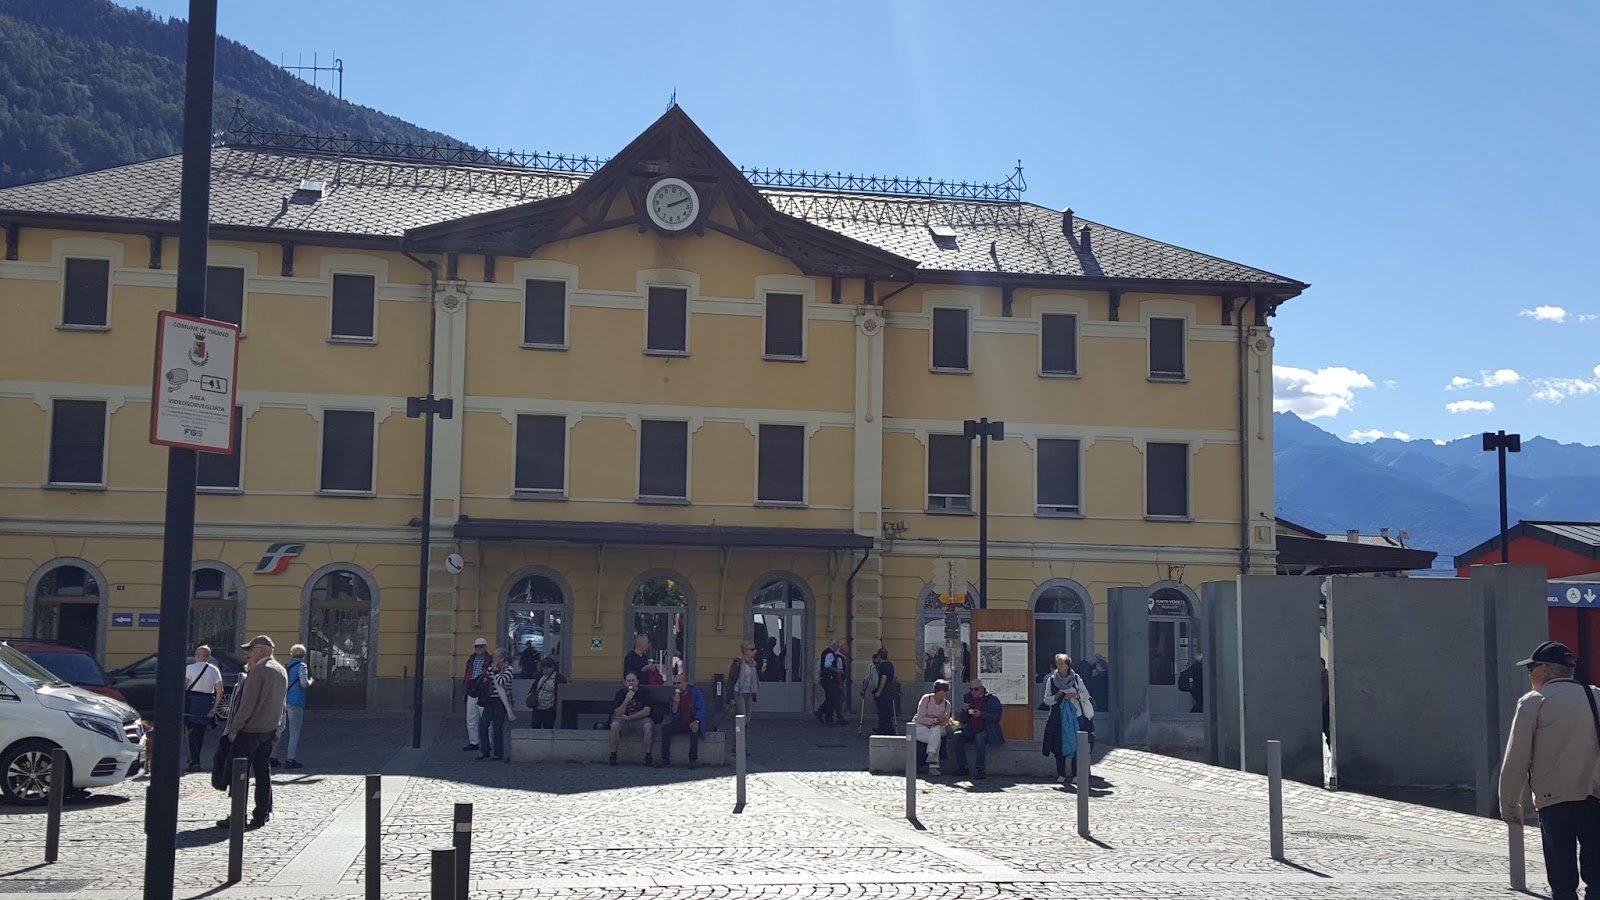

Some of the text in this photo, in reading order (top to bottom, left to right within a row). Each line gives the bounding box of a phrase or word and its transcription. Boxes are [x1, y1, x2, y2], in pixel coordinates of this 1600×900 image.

[173, 322, 198, 332] COMUNE
[208, 329, 229, 338] TIRANO
[168, 399, 225, 412] VIDEOSORVEGLIATA
